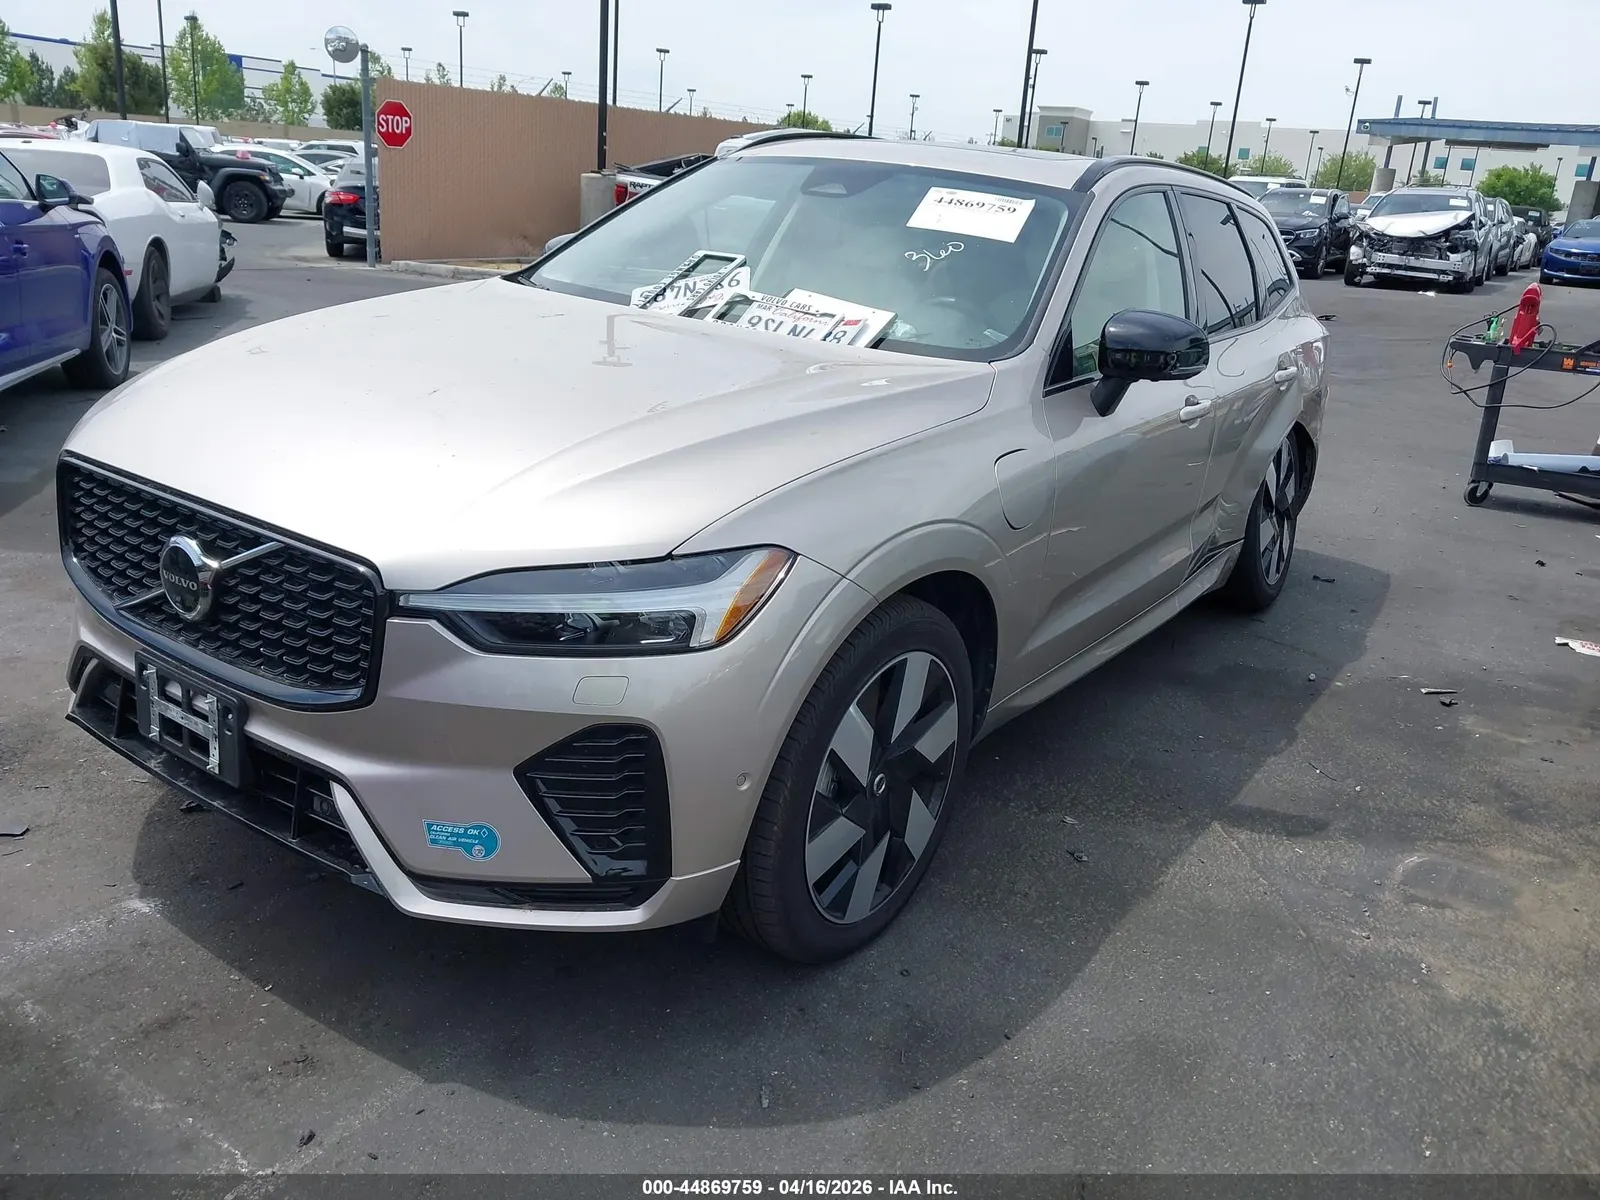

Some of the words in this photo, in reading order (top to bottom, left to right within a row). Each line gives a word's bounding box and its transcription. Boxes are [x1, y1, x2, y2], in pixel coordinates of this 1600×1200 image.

[378, 114, 411, 134] STOP
[933, 196, 1017, 214] 44869759
[755, 303, 773, 311] MAR
[760, 294, 788, 306] VOLVO
[789, 301, 813, 311] CARS
[771, 307, 829, 325] Californi
[163, 569, 198, 591] VOLVO
[431, 825, 465, 834] ACCESS
[467, 828, 481, 836] OK
